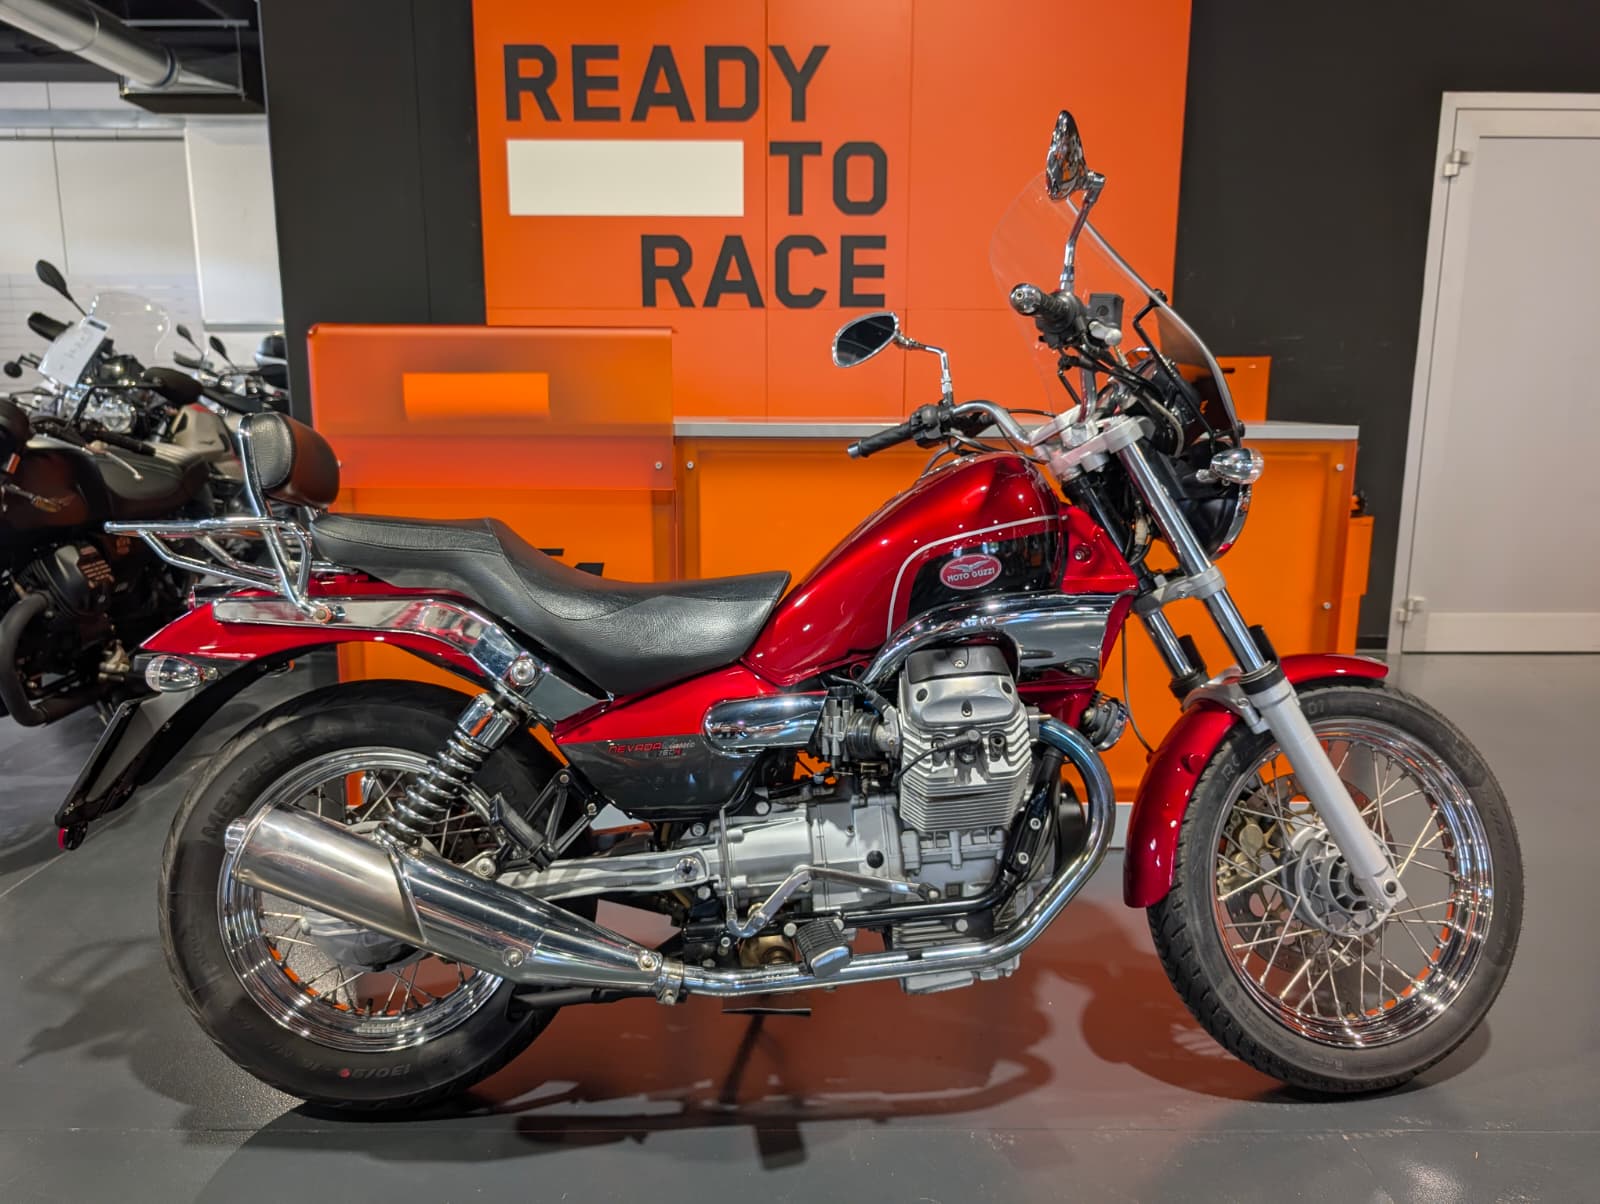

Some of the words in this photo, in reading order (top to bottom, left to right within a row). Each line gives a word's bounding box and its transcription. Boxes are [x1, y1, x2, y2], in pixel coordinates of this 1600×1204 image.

[504, 44, 829, 122] READY
[770, 141, 888, 216] TO
[641, 234, 887, 308] RACE
[946, 572, 970, 583] MOTO
[971, 567, 995, 578] GUZZI
[608, 742, 662, 753] NEVADA
